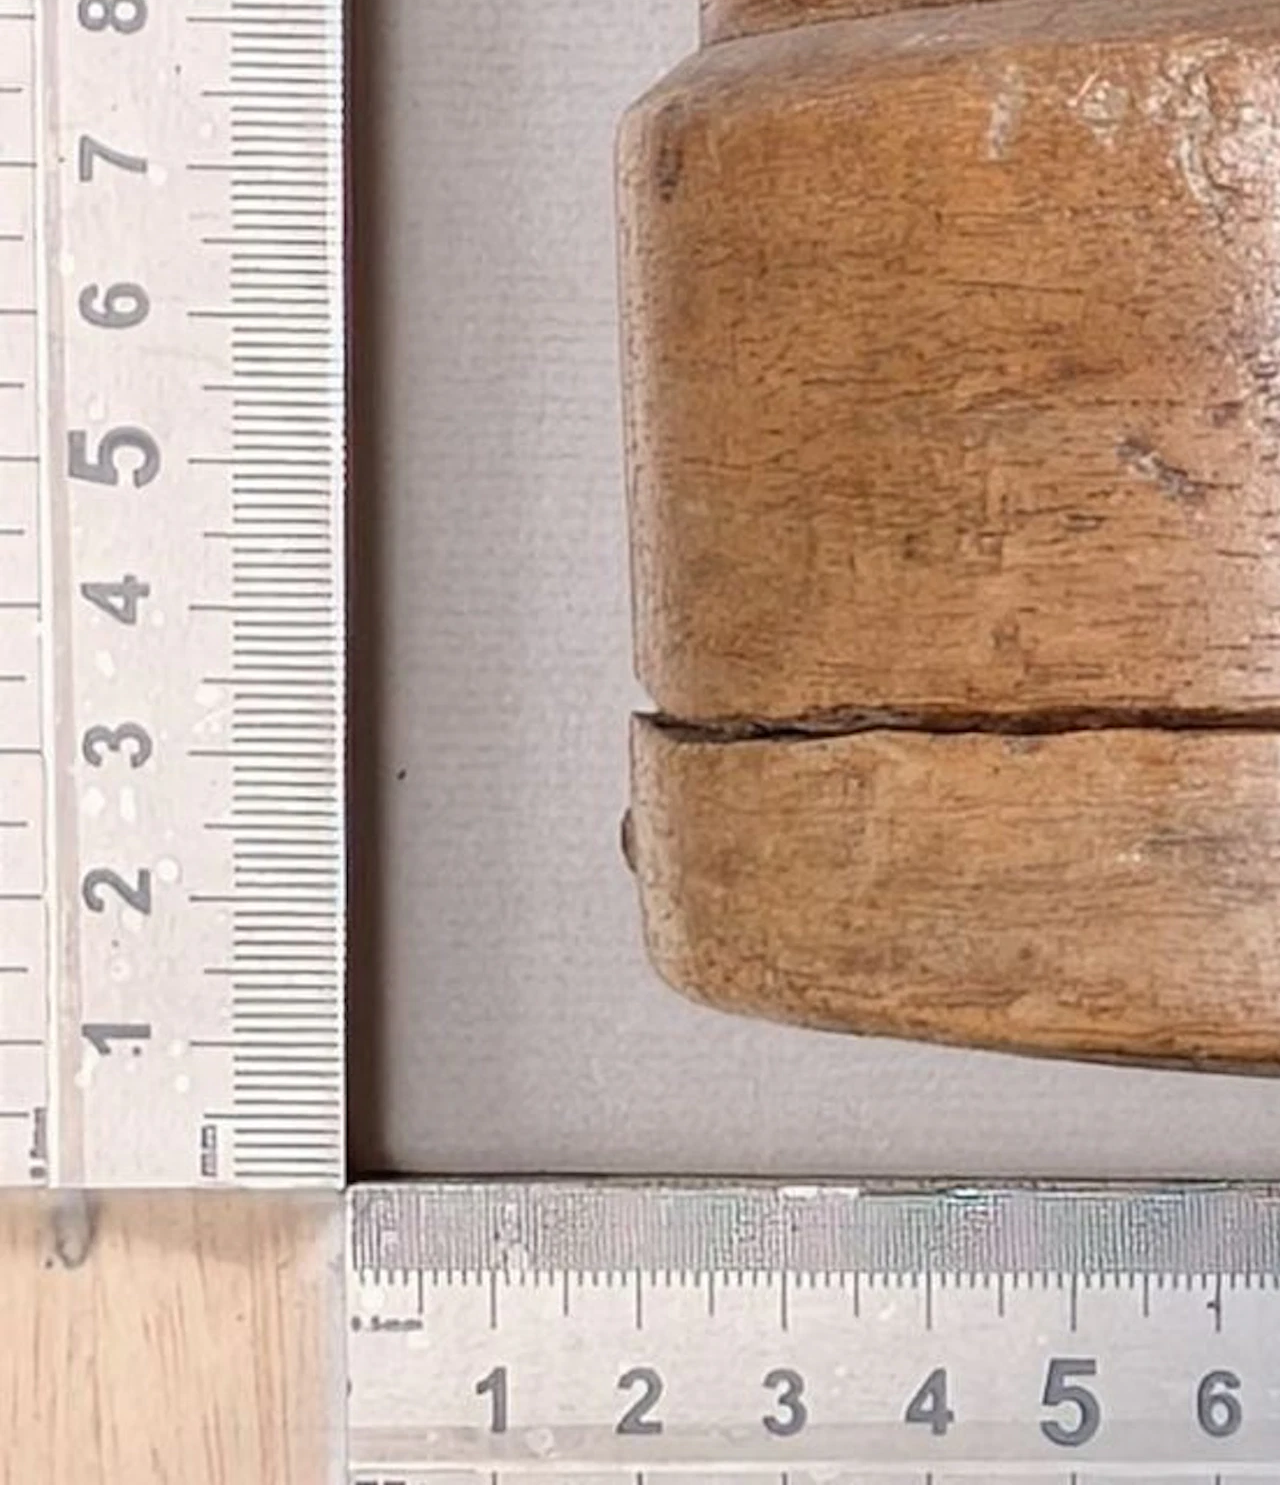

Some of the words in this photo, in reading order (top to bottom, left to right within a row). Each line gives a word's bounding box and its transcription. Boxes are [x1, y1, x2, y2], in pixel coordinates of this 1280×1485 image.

[78, 134, 149, 184] 7
[77, 282, 151, 331] 6
[68, 426, 161, 490] 5
[79, 573, 151, 627] 4
[81, 721, 154, 770] 3
[80, 867, 153, 917] 2
[79, 1022, 153, 1058] 1
[475, 1365, 509, 1437] 1
[615, 1366, 665, 1438] 2
[761, 1367, 808, 1439] 3
[903, 1367, 955, 1437] 4
[1039, 1357, 1101, 1449] 5
[1196, 1369, 1243, 1439] 6
